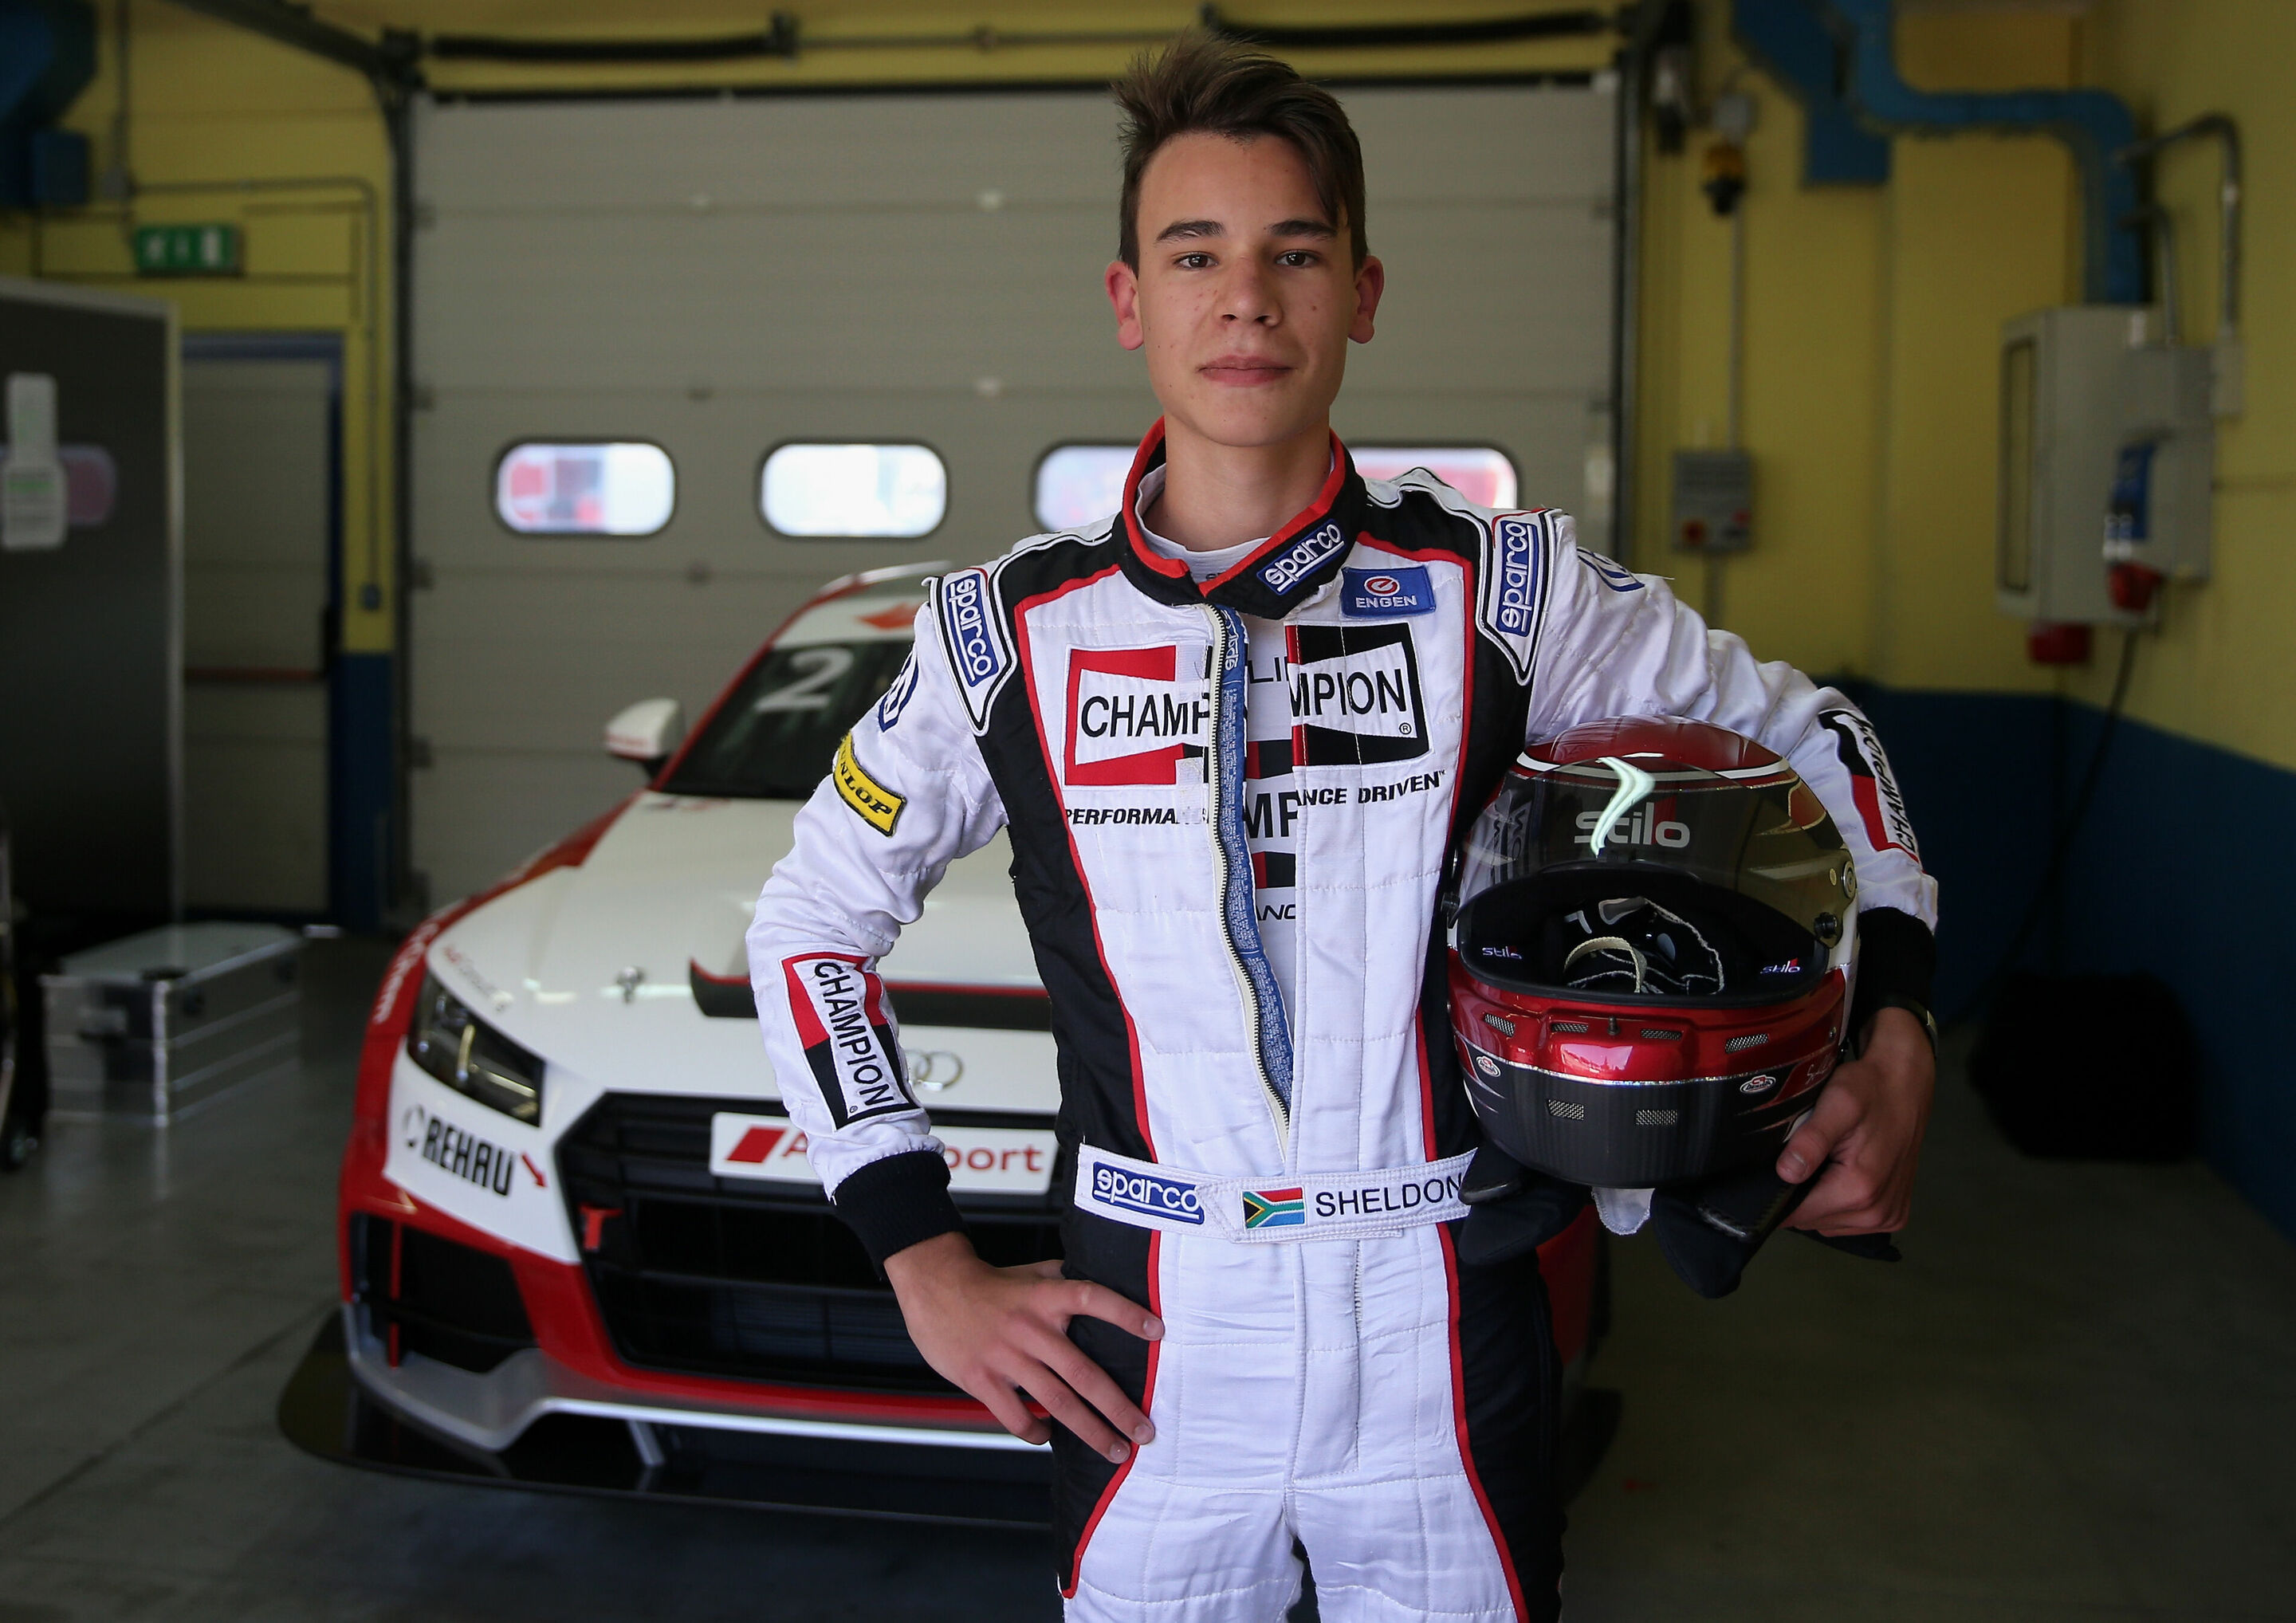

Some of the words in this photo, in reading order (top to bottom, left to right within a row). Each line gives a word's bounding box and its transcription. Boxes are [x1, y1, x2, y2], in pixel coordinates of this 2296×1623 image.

[1264, 523, 1342, 586] sparco
[1501, 522, 1531, 629] sparco
[949, 578, 993, 676] sparco
[1355, 595, 1417, 609] ENGEN
[756, 648, 853, 712] 2
[1760, 959, 1802, 974] stilo
[814, 962, 894, 1106] CHAMPION
[423, 1118, 512, 1196] REHAU
[1096, 1169, 1200, 1220] sparco
[1315, 1173, 1463, 1217] SHELDON
